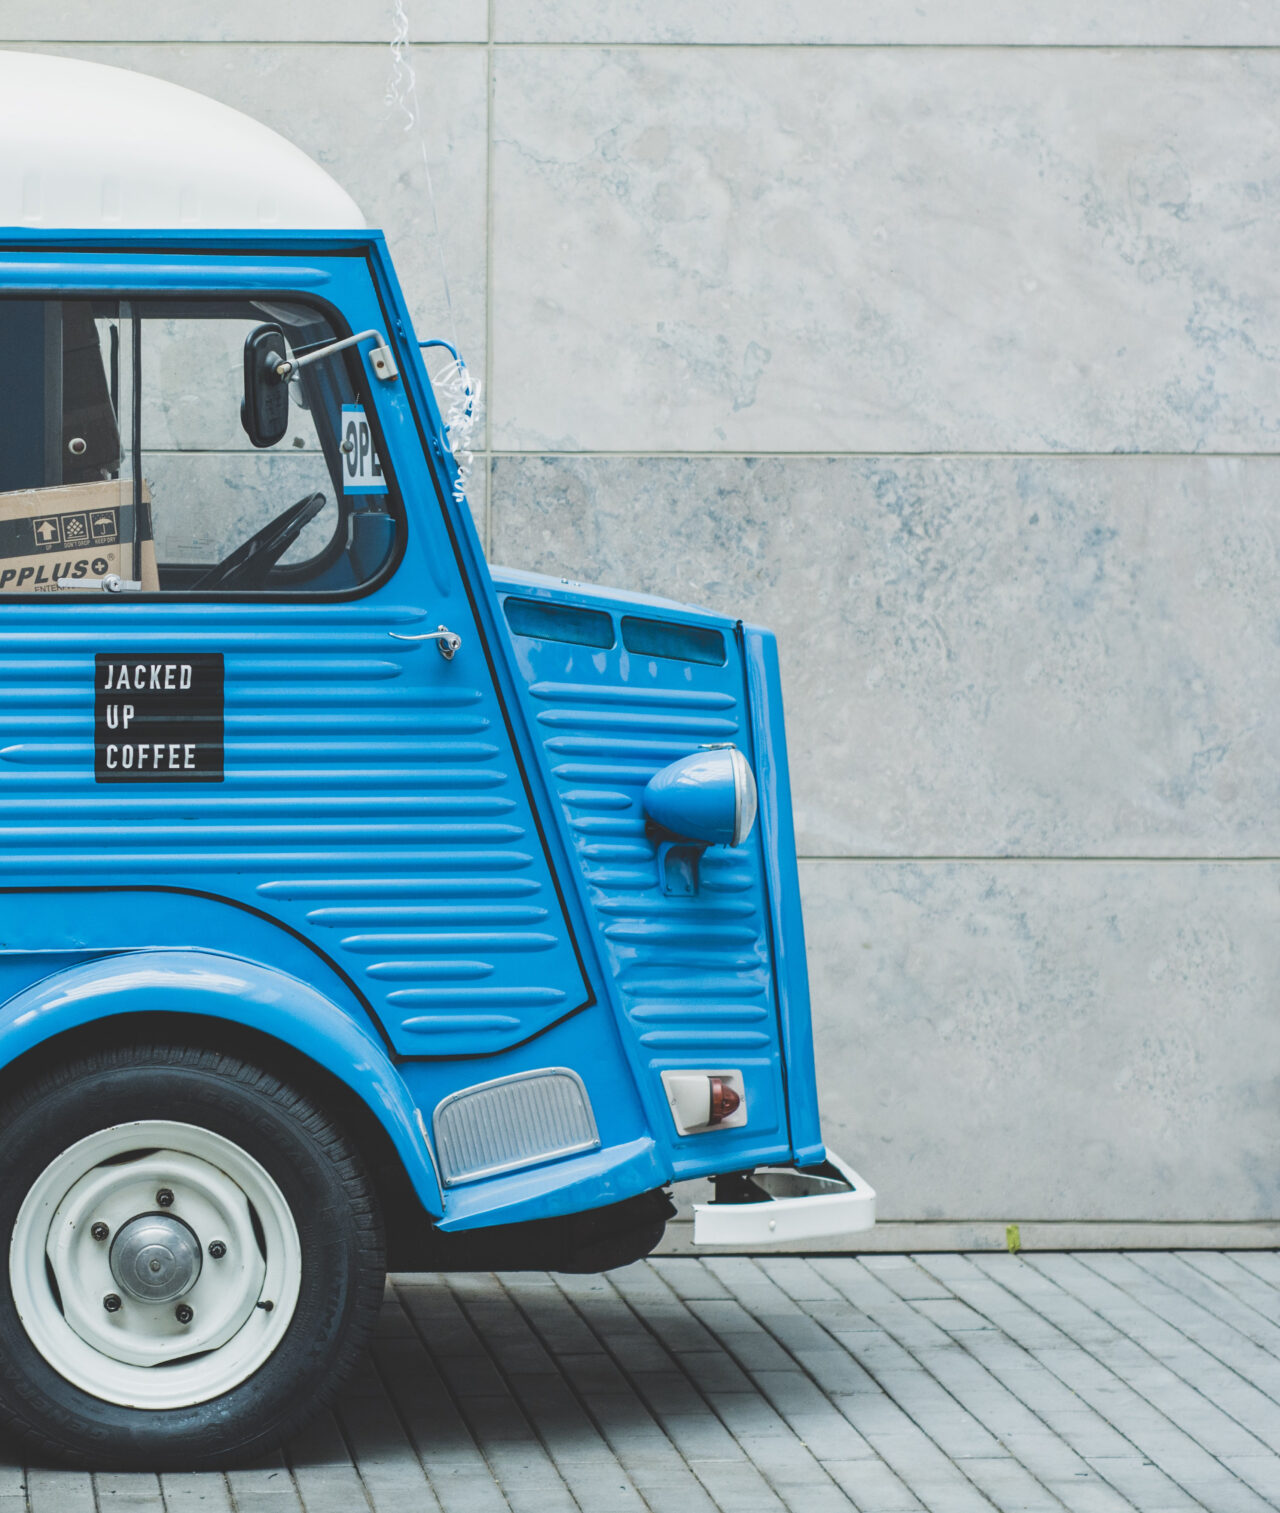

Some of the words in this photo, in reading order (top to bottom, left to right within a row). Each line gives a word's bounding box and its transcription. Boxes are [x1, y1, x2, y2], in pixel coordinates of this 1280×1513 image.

[104, 665, 192, 689] JACKED
[106, 705, 134, 729] UP
[106, 744, 195, 769] COFFEE
